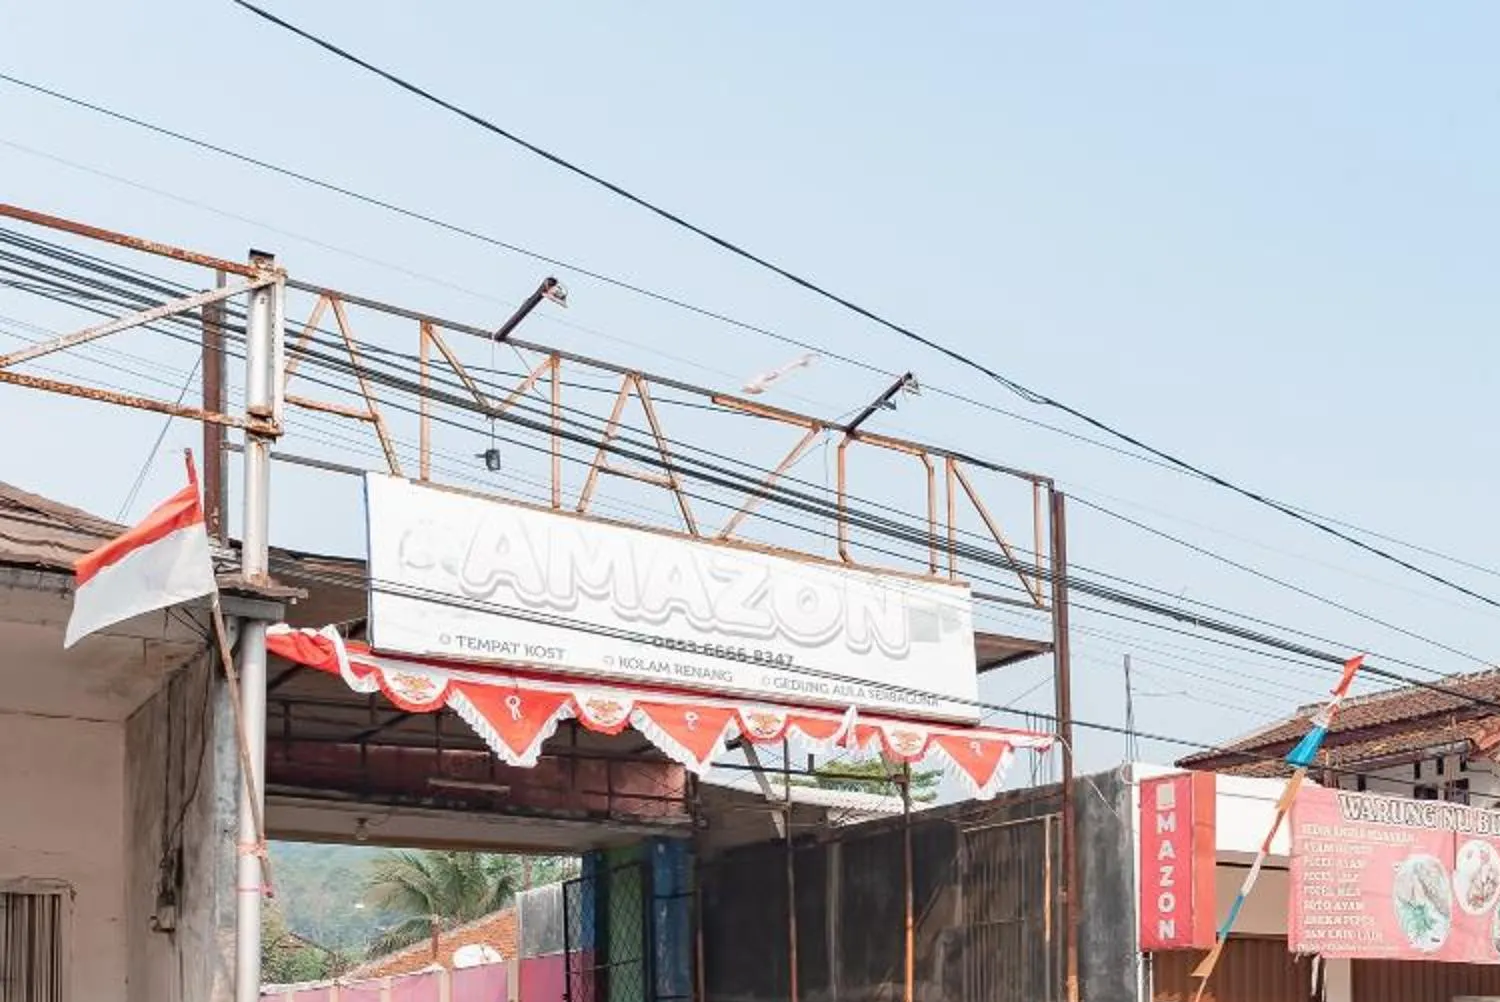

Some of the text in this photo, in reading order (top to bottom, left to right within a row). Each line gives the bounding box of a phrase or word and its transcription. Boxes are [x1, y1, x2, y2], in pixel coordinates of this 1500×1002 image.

[459, 506, 912, 660] AMAZON
[456, 635, 566, 660] TEMPAT KOST
[618, 656, 734, 683] KOLAM RENANG
[773, 677, 830, 695] GEDUNG
[832, 684, 865, 698] AULA
[1339, 792, 1439, 829] WARUNG
[1156, 783, 1177, 939] MAZON
